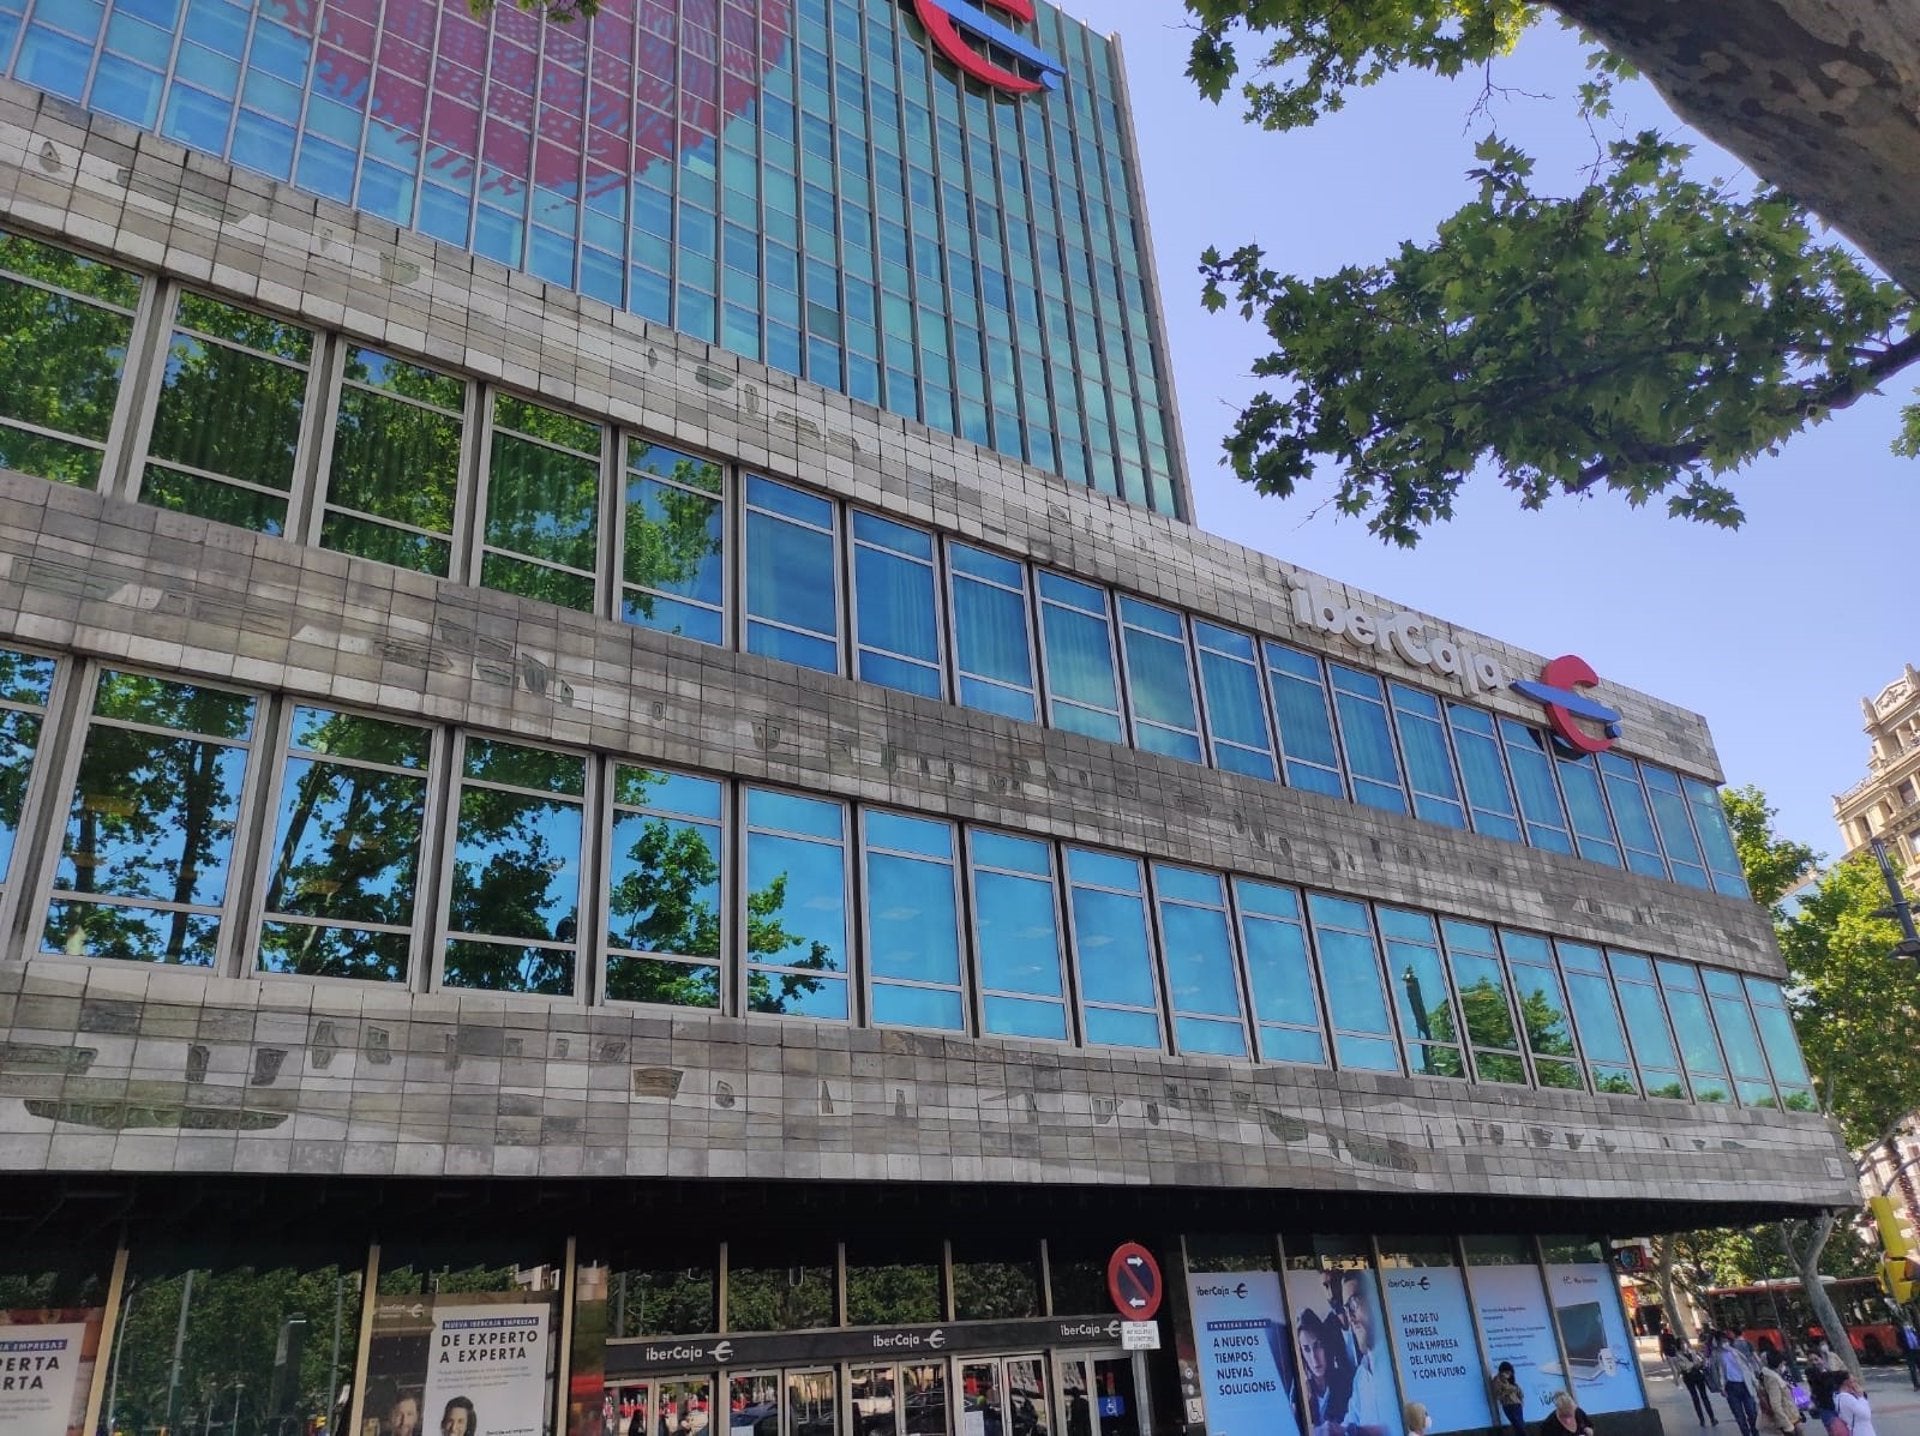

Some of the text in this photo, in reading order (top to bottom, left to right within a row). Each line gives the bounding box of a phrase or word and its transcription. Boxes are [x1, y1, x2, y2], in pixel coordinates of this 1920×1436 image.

[1287, 572, 1506, 697] iberCaja
[1195, 1285, 1230, 1297] iberCaja
[1401, 1313, 1418, 1323] HAZ
[1430, 1312, 1440, 1322] TU
[1060, 1323, 1101, 1337] iberCaja
[1404, 1326, 1439, 1337] EMPRESA
[441, 1330, 538, 1347] DE EXPERTO
[873, 1334, 920, 1348] iberCaja
[1213, 1335, 1260, 1348] A NUEVOS
[1407, 1339, 1459, 1352] UNA EMPRESA
[439, 1347, 527, 1363] A EXPERTA
[646, 1348, 703, 1362] iberCaja
[1409, 1353, 1454, 1366] DEL FUTURO
[1216, 1366, 1254, 1380] NUEVAS
[1412, 1365, 1467, 1380] Y CON FUTURO
[1218, 1380, 1277, 1396] SOLUCIONES
